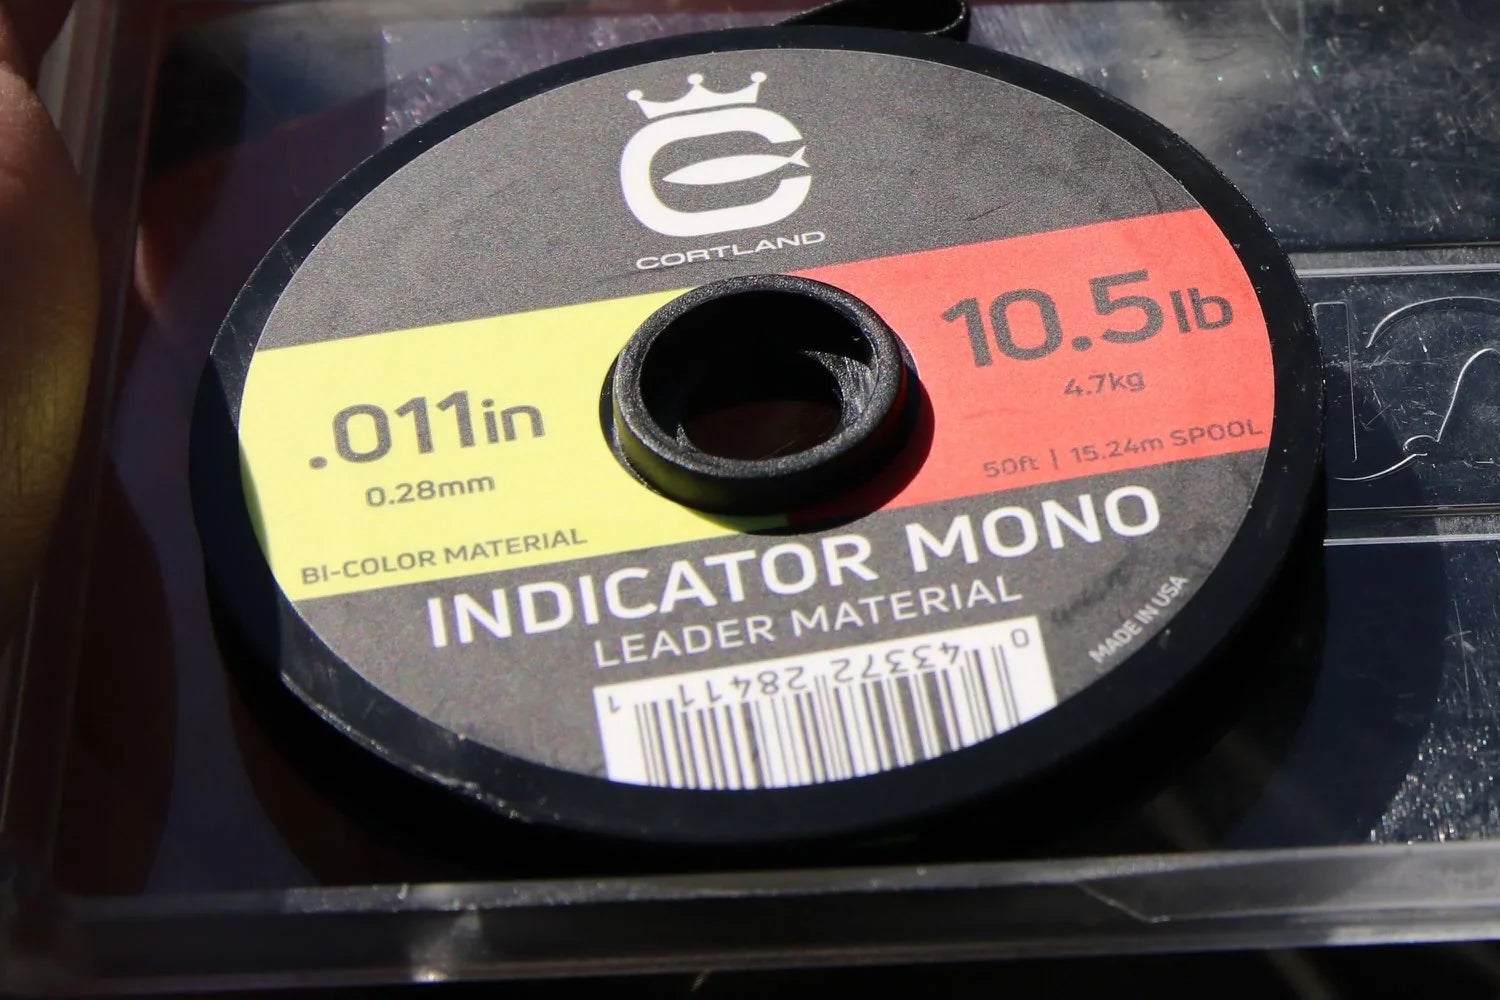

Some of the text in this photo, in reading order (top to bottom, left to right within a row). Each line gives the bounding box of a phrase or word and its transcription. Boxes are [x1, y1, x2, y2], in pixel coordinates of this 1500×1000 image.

[635, 230, 826, 271] CORTLAND
[1064, 370, 1146, 398] 4.7kg
[308, 390, 545, 470] .011in
[982, 455, 1040, 478] 50ft
[1071, 437, 1165, 463] 15.24m
[1168, 419, 1264, 447] SPOOL
[365, 475, 496, 507] 0.28mm
[301, 527, 588, 585] BI-COLOR MATERIAL
[426, 484, 1160, 648] INDICATOR MONO
[594, 576, 1024, 668] LEADER MATERIAL
[1088, 576, 1190, 664] MADE IN USA
[829, 641, 961, 682] 43372
